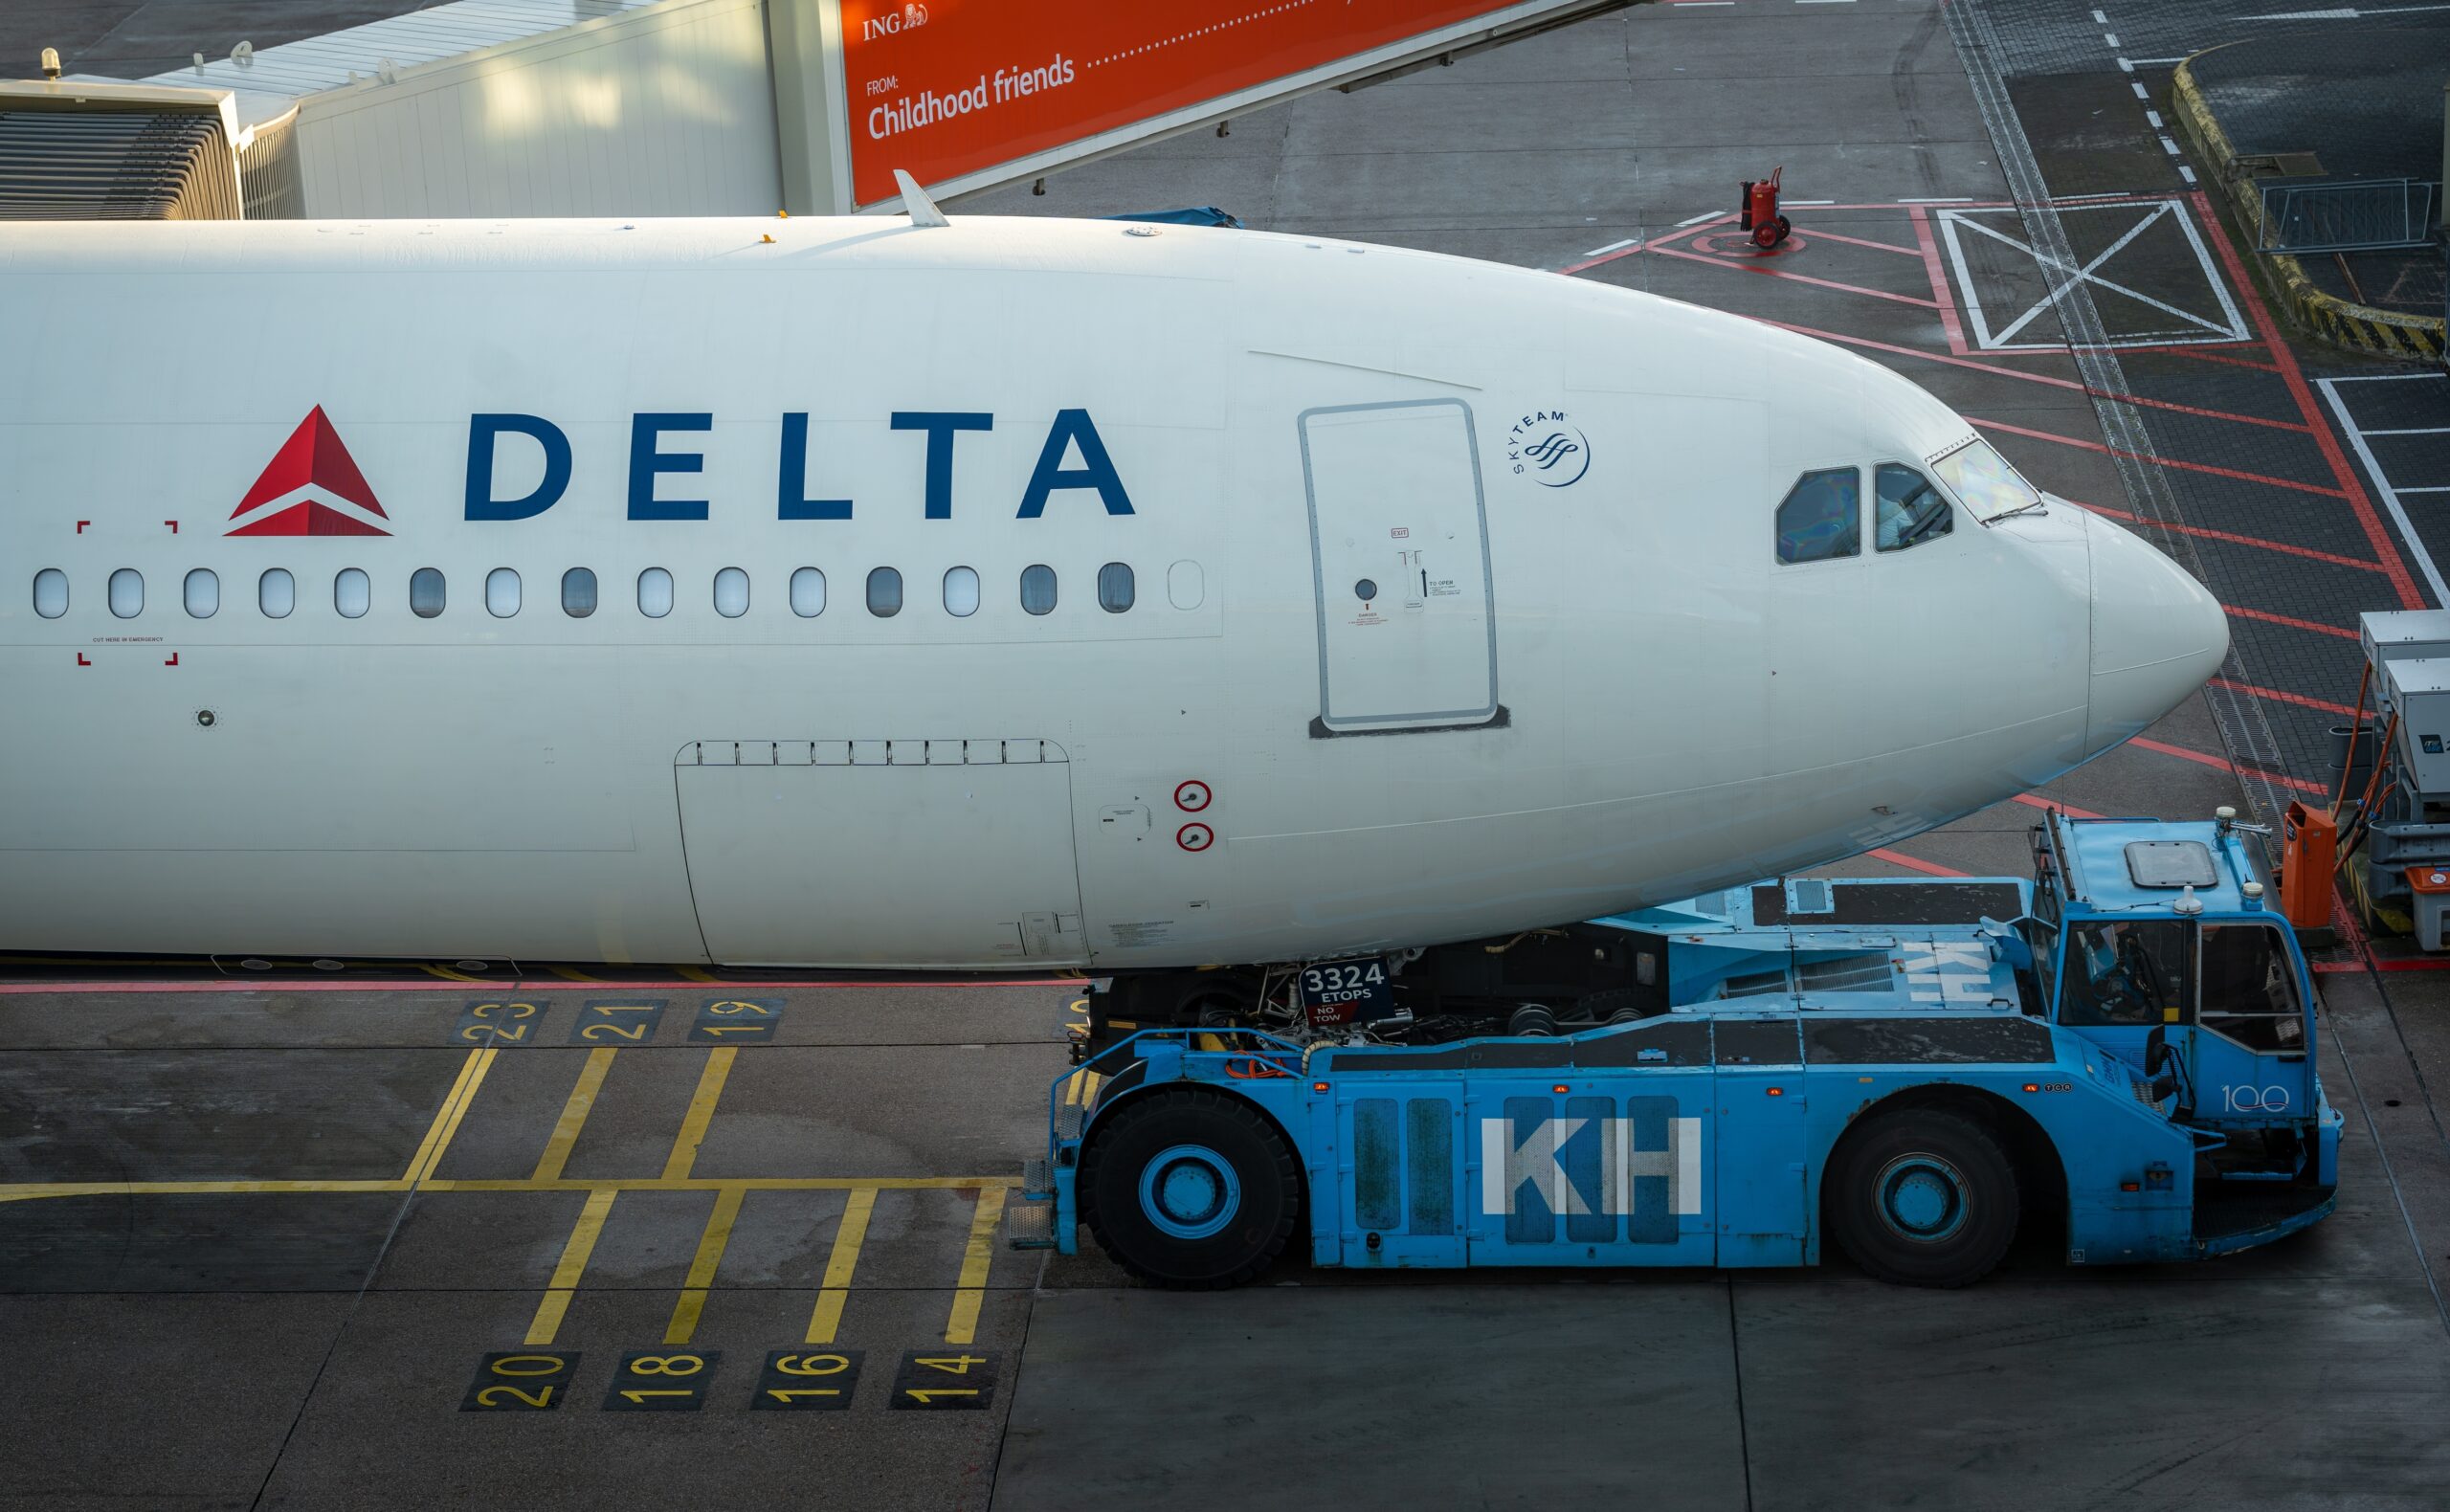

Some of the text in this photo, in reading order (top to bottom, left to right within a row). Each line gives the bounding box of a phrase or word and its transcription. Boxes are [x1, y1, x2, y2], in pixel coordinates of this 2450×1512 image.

[862, 12, 901, 41] ING
[866, 75, 900, 97] FROM:
[868, 53, 1075, 140] Childhood friends
[1507, 411, 1565, 475] SKYTEAM
[464, 409, 1135, 521] DELTA
[1305, 963, 1385, 991] 3324
[1321, 988, 1372, 1003] ETOPS
[461, 1003, 536, 1041] 23
[582, 1005, 656, 1040] 21
[702, 1000, 770, 1039] 19
[2045, 1083, 2072, 1093] TCR
[2220, 1085, 2290, 1113] 100
[1481, 1117, 1702, 1215] KH
[477, 1354, 565, 1408] 20
[619, 1353, 704, 1405] 18
[766, 1353, 850, 1405] 16
[904, 1353, 988, 1405] 14
